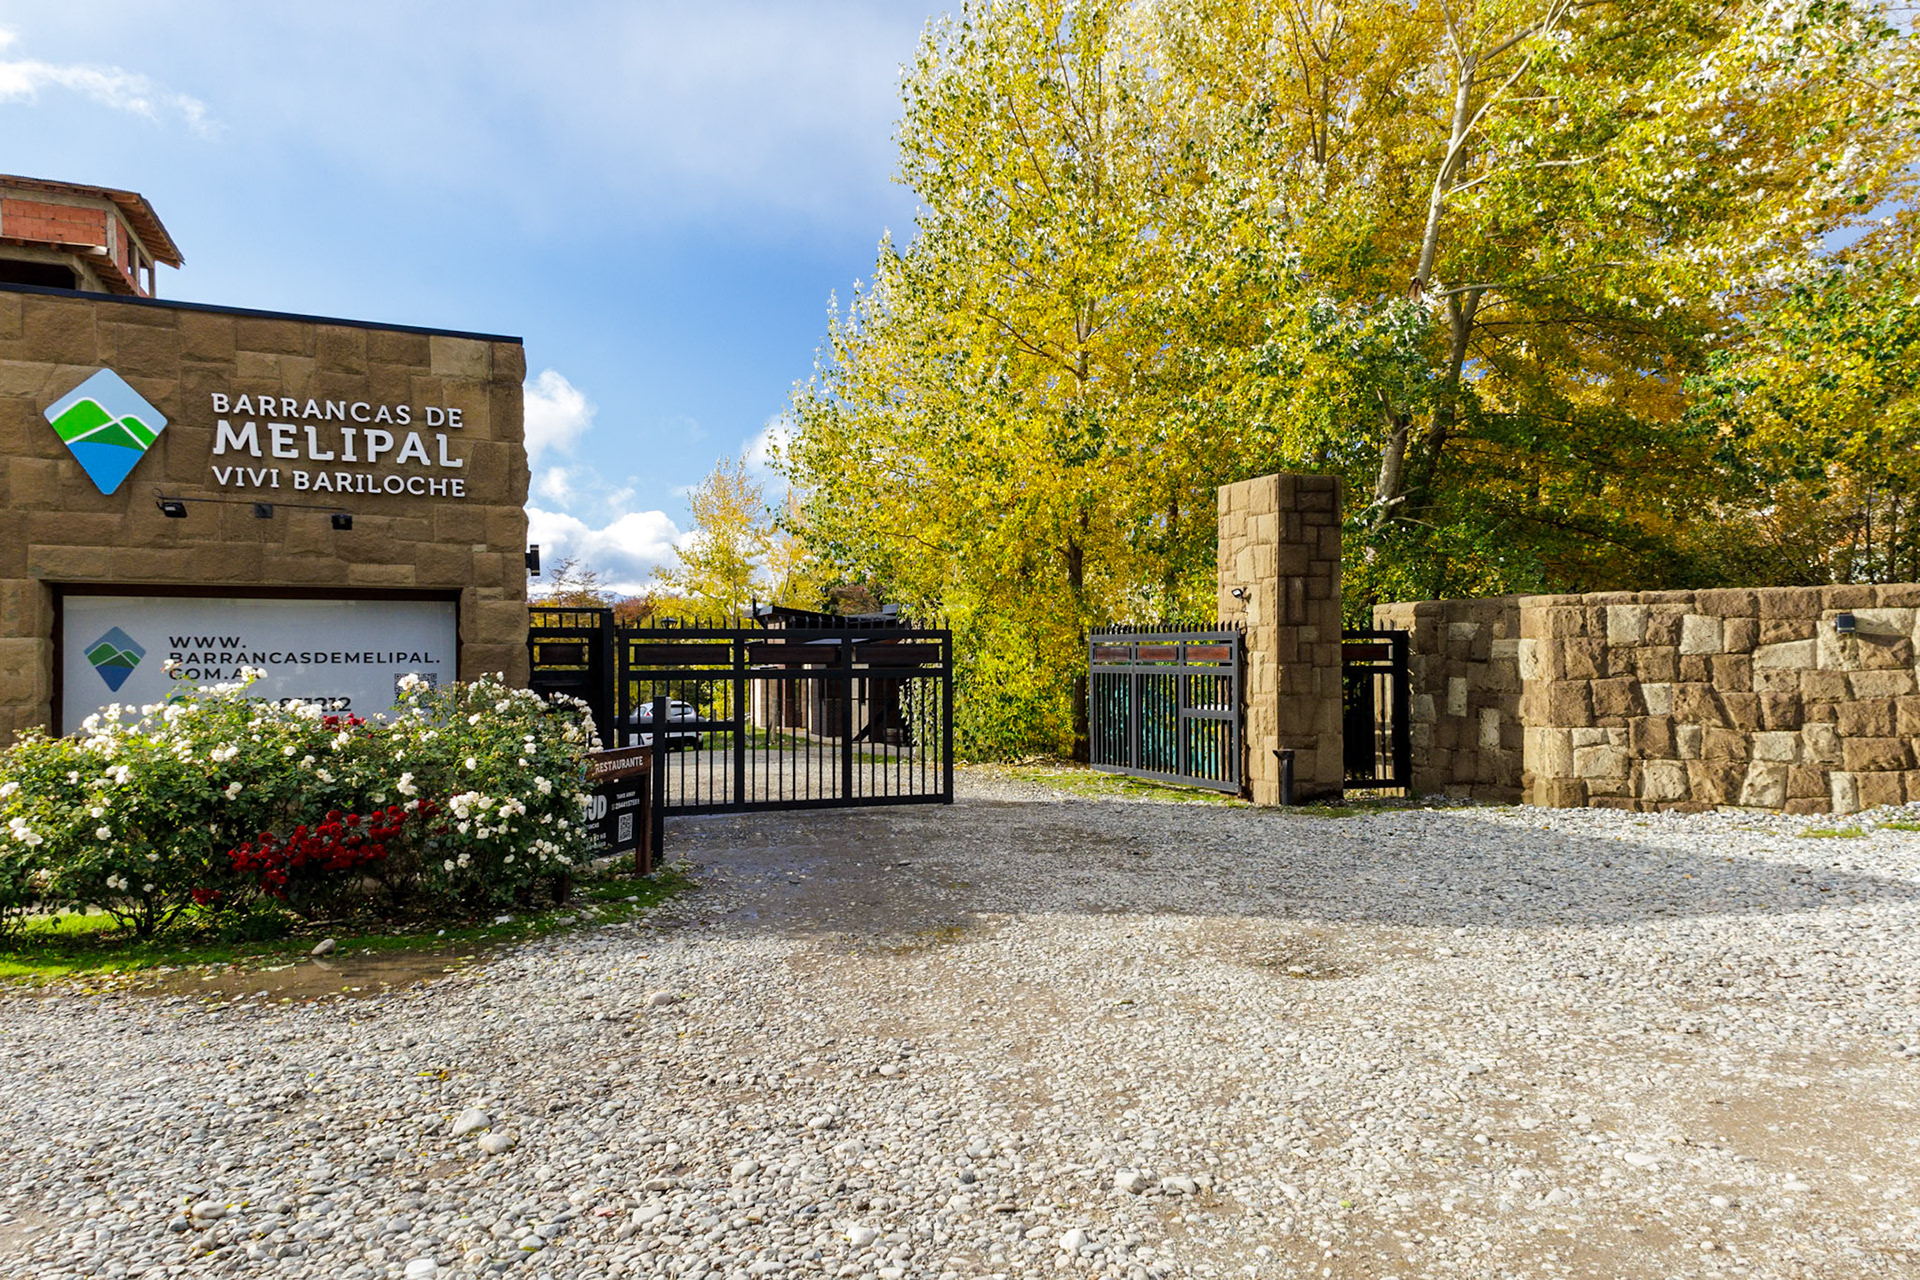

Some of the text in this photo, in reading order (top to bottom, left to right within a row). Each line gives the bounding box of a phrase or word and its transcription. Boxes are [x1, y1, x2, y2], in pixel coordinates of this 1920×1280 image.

[211, 392, 463, 428] BARRANCAS DE
[212, 419, 464, 468] MELIPAL
[212, 465, 466, 497] VIVI BARILOCHE
[169, 636, 247, 649] WWW.
[169, 651, 441, 664] BARRANCASDEMELIPAL.
